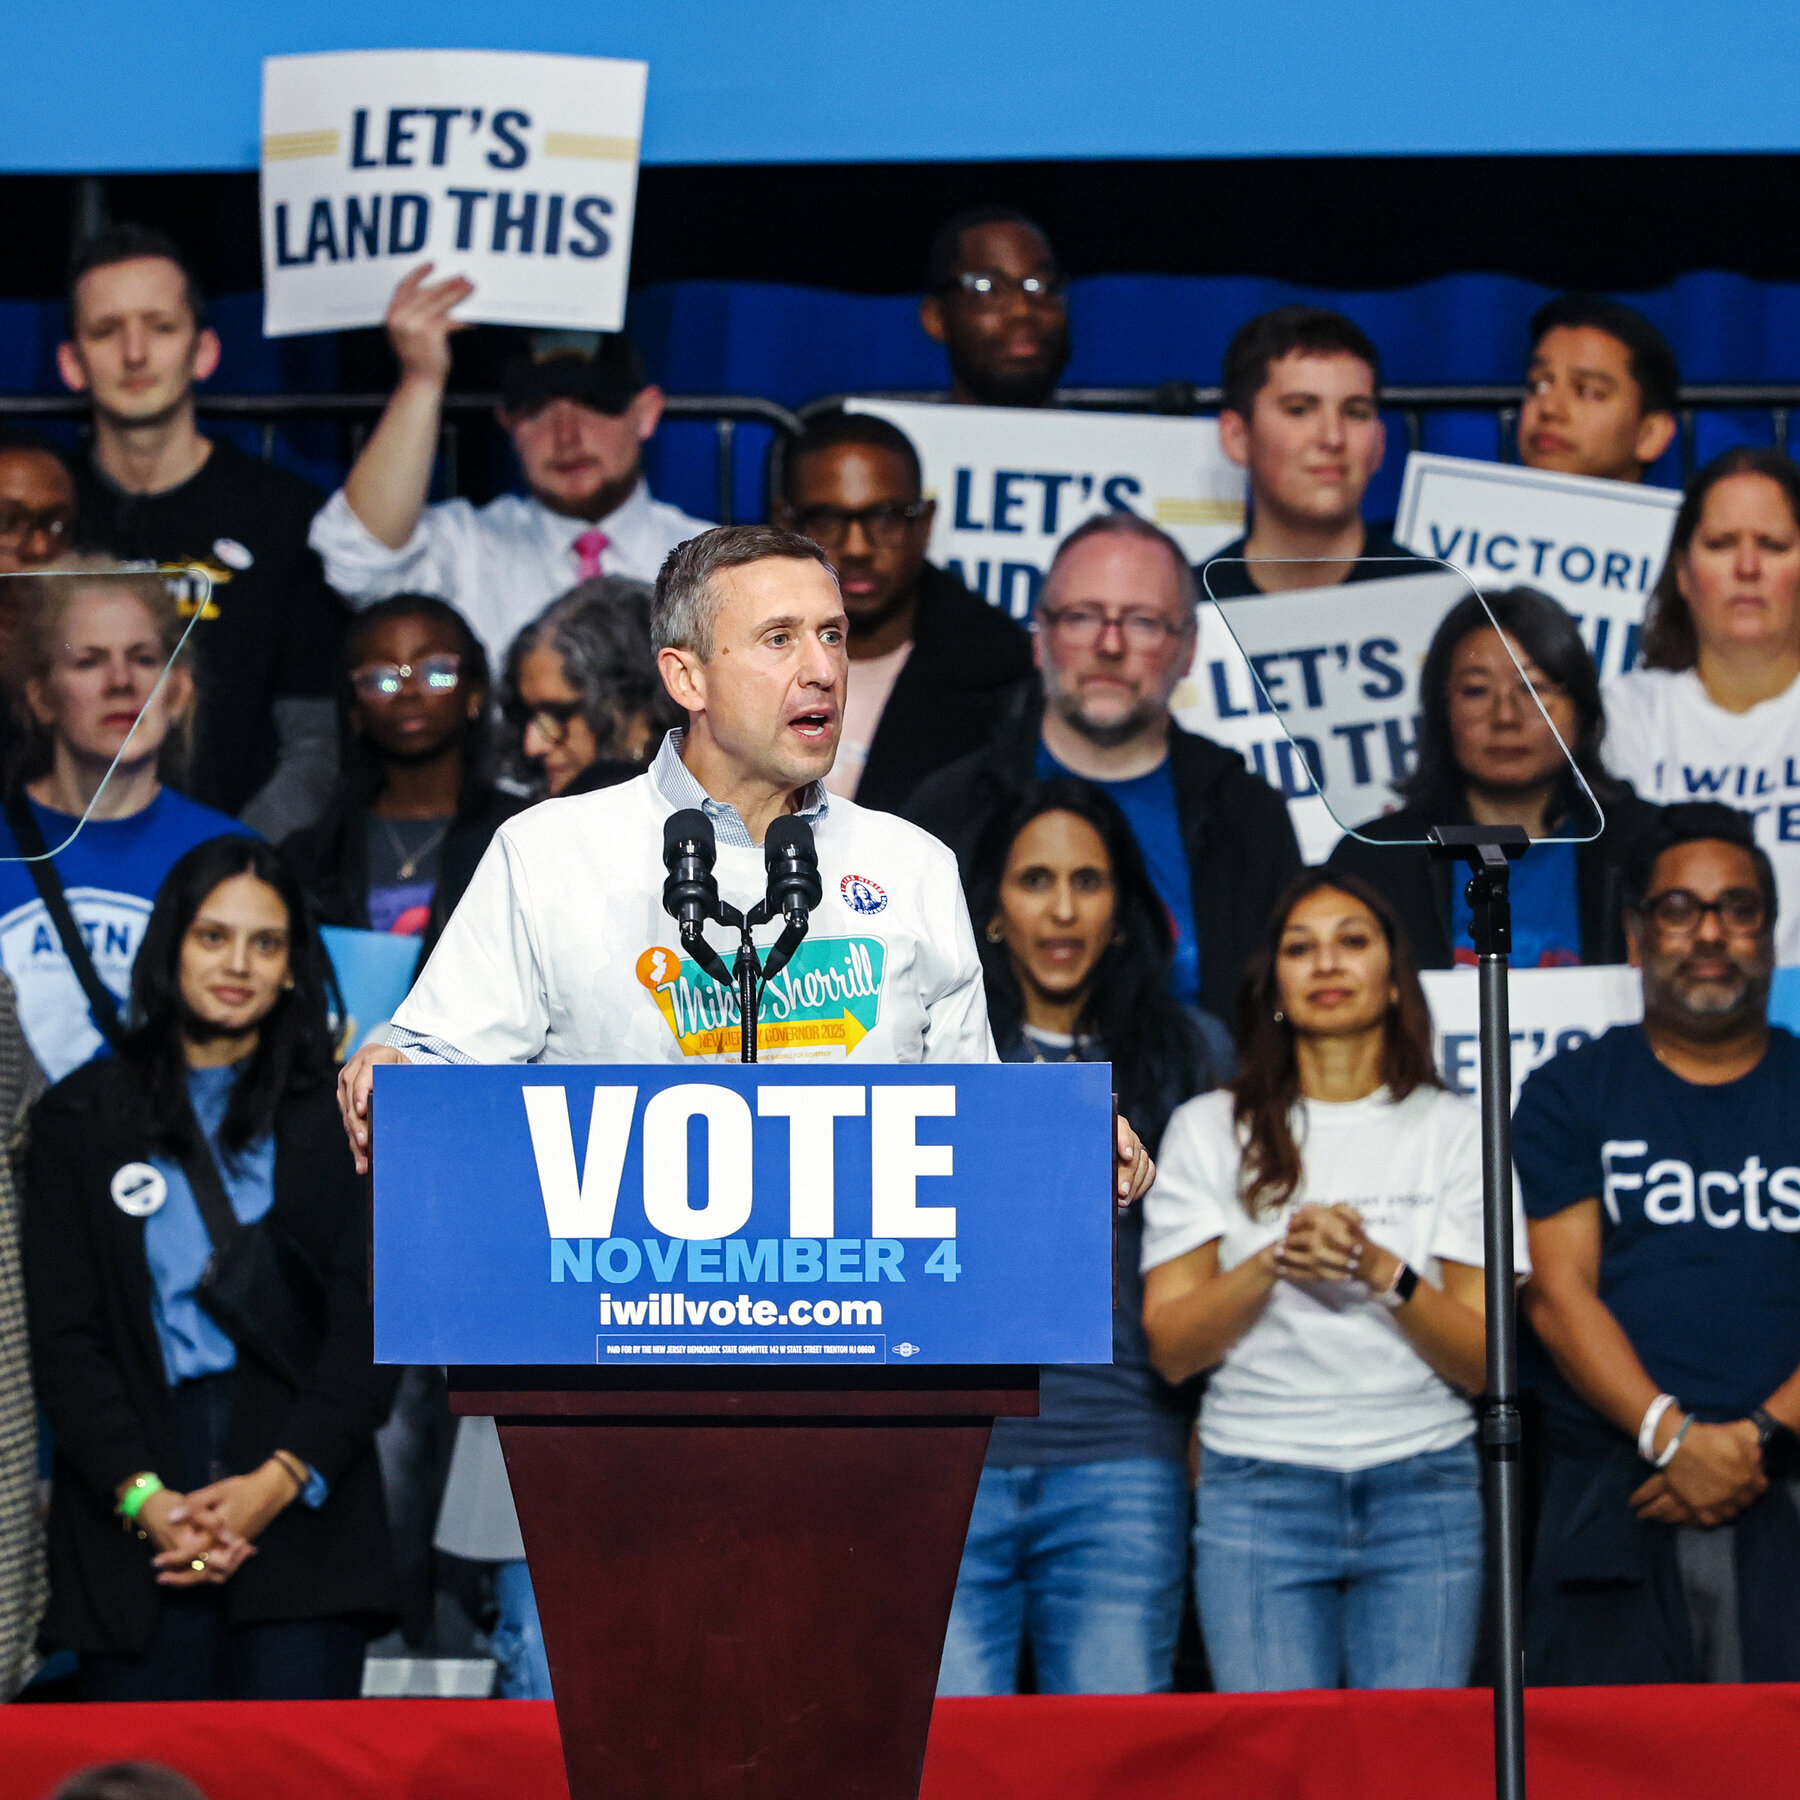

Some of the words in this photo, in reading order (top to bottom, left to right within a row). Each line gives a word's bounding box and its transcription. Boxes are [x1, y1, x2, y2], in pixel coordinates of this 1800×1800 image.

[348, 106, 532, 170] LET'S
[275, 193, 432, 269] LAND
[446, 186, 615, 259] THIS
[953, 467, 1144, 534] LET'S
[1428, 523, 1653, 592] VICTORI
[1208, 638, 1406, 719] LET'S
[773, 942, 880, 1019] Sherrill
[699, 1031, 723, 1048] NEW
[765, 1025, 819, 1042] GOVERNOR
[822, 1023, 846, 1040] 2025
[522, 1083, 957, 1240] VOTE
[1601, 1140, 1800, 1232] Facts
[551, 1238, 906, 1284] NOVEMBER
[924, 1239, 962, 1283] 4
[600, 1293, 882, 1326] iwillvote.com
[607, 1344, 620, 1355] PAID
[621, 1344, 632, 1355] FOR
[633, 1344, 641, 1355] BY
[642, 1344, 652, 1355] THE
[653, 1344, 665, 1355] NEW
[667, 1344, 685, 1355] JERSEY
[687, 1344, 721, 1355] DEMOCRATIC
[722, 1344, 737, 1355] STATE
[738, 1344, 768, 1355] COMMITTEE
[780, 1344, 786, 1355] W
[787, 1344, 802, 1355] STATE
[803, 1344, 822, 1355] STREET
[823, 1344, 848, 1355] TRENTON
[849, 1344, 856, 1355] NJ
